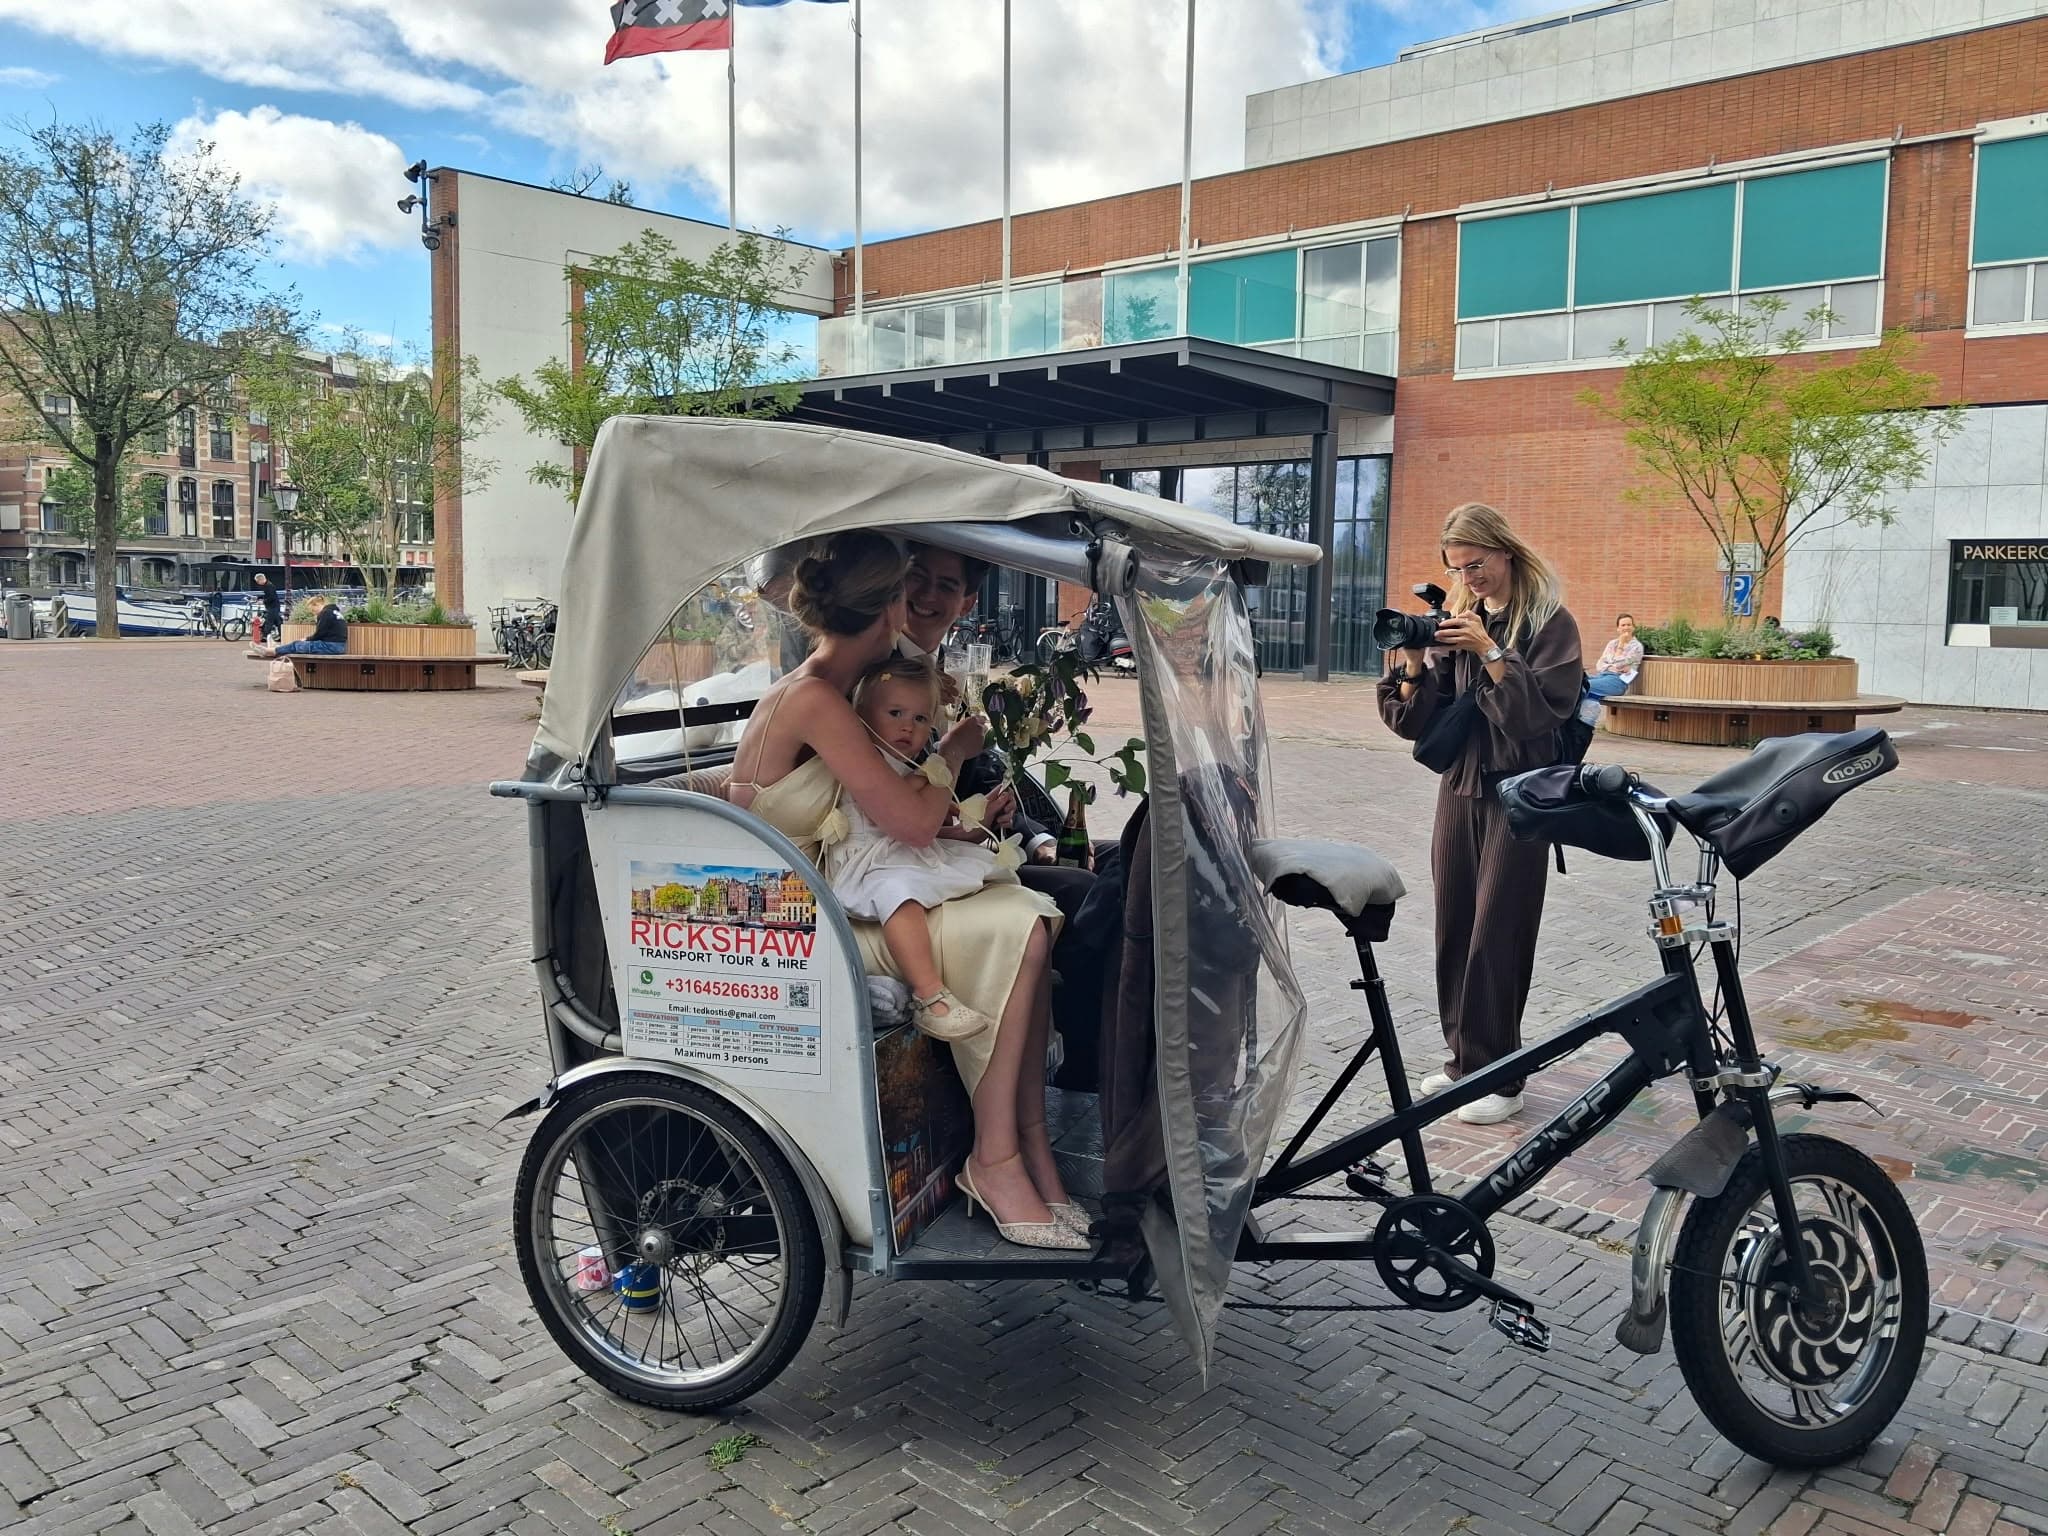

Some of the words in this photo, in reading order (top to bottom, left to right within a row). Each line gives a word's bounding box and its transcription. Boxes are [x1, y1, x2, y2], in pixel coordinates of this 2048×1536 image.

[631, 920, 816, 958] RICKSHAW
[639, 947, 712, 962] TRANSPORT
[720, 954, 754, 966] TOUR
[761, 957, 769, 967] &
[778, 958, 808, 970] HIRE
[666, 978, 779, 1001] +31645266338
[668, 1003, 692, 1013] Email:
[675, 1047, 720, 1060] Maximum
[724, 1052, 729, 1061] 3
[732, 1054, 769, 1064] persons
